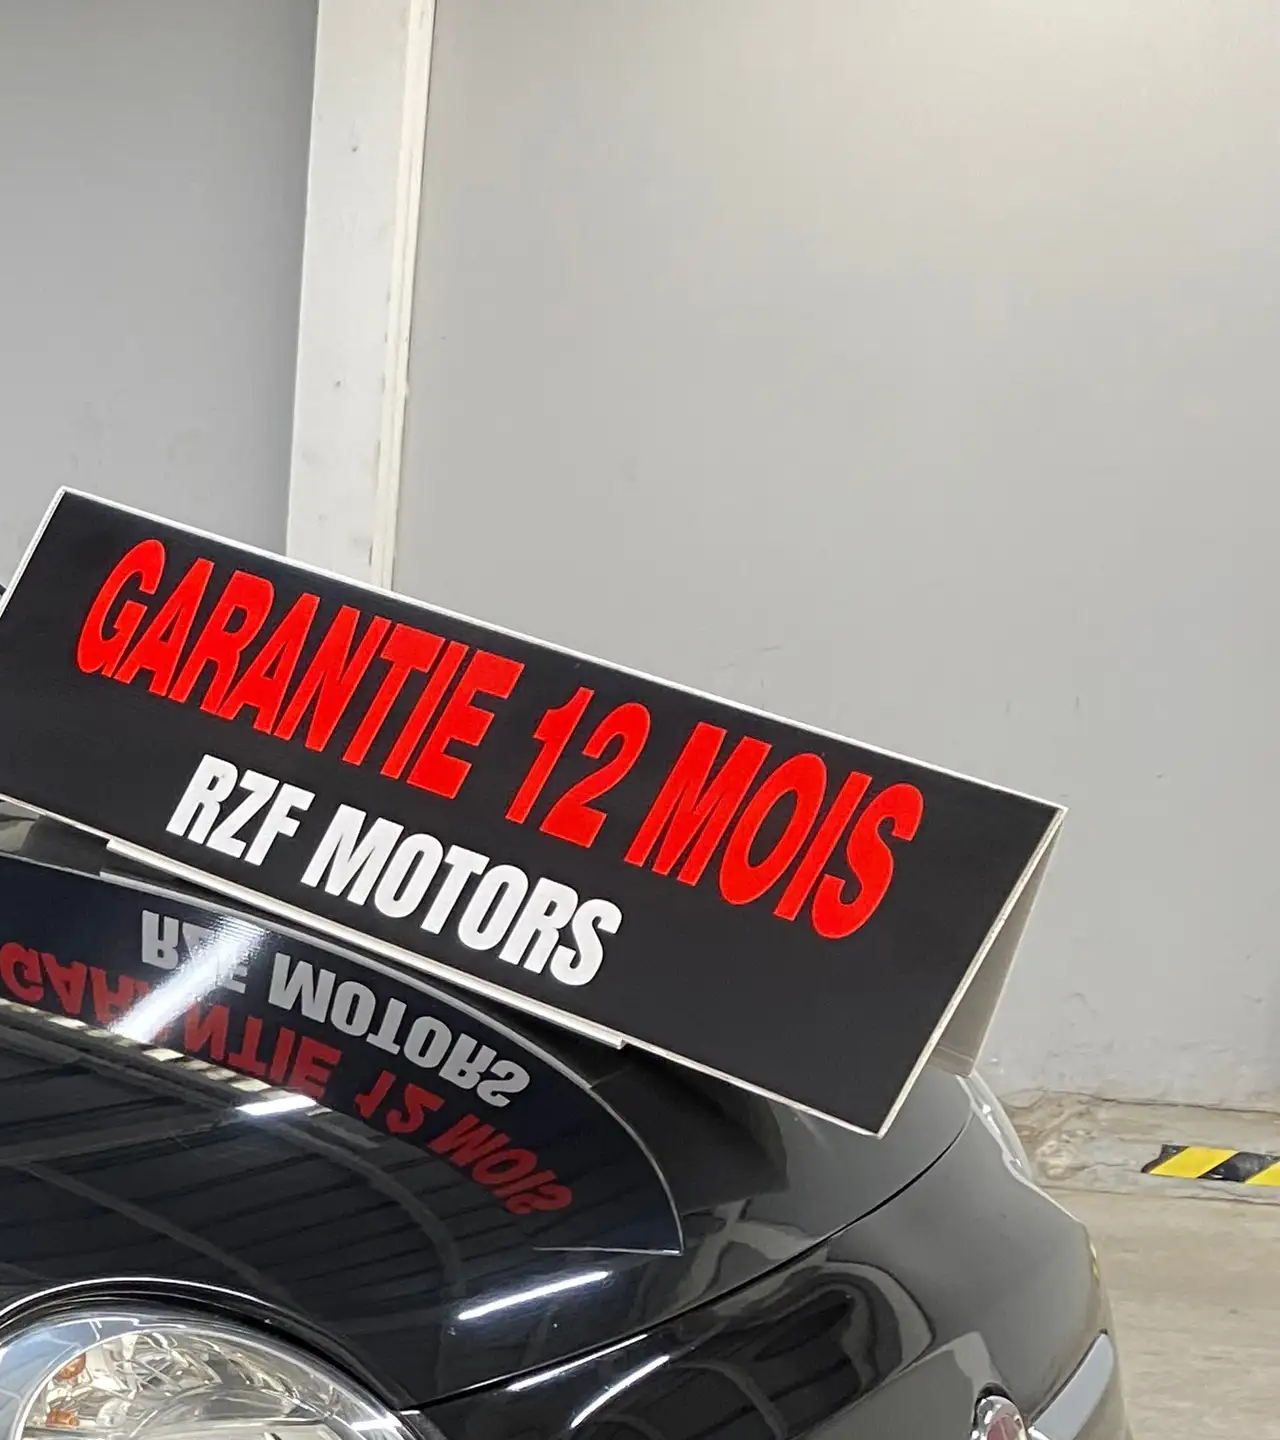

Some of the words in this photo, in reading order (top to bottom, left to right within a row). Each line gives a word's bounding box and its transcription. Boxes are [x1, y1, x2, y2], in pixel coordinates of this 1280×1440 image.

[76, 539, 524, 800] GARANTIE
[505, 686, 651, 849] 12
[623, 721, 924, 940] MOIS
[166, 754, 315, 866] RZF
[300, 803, 623, 987] MOTORS
